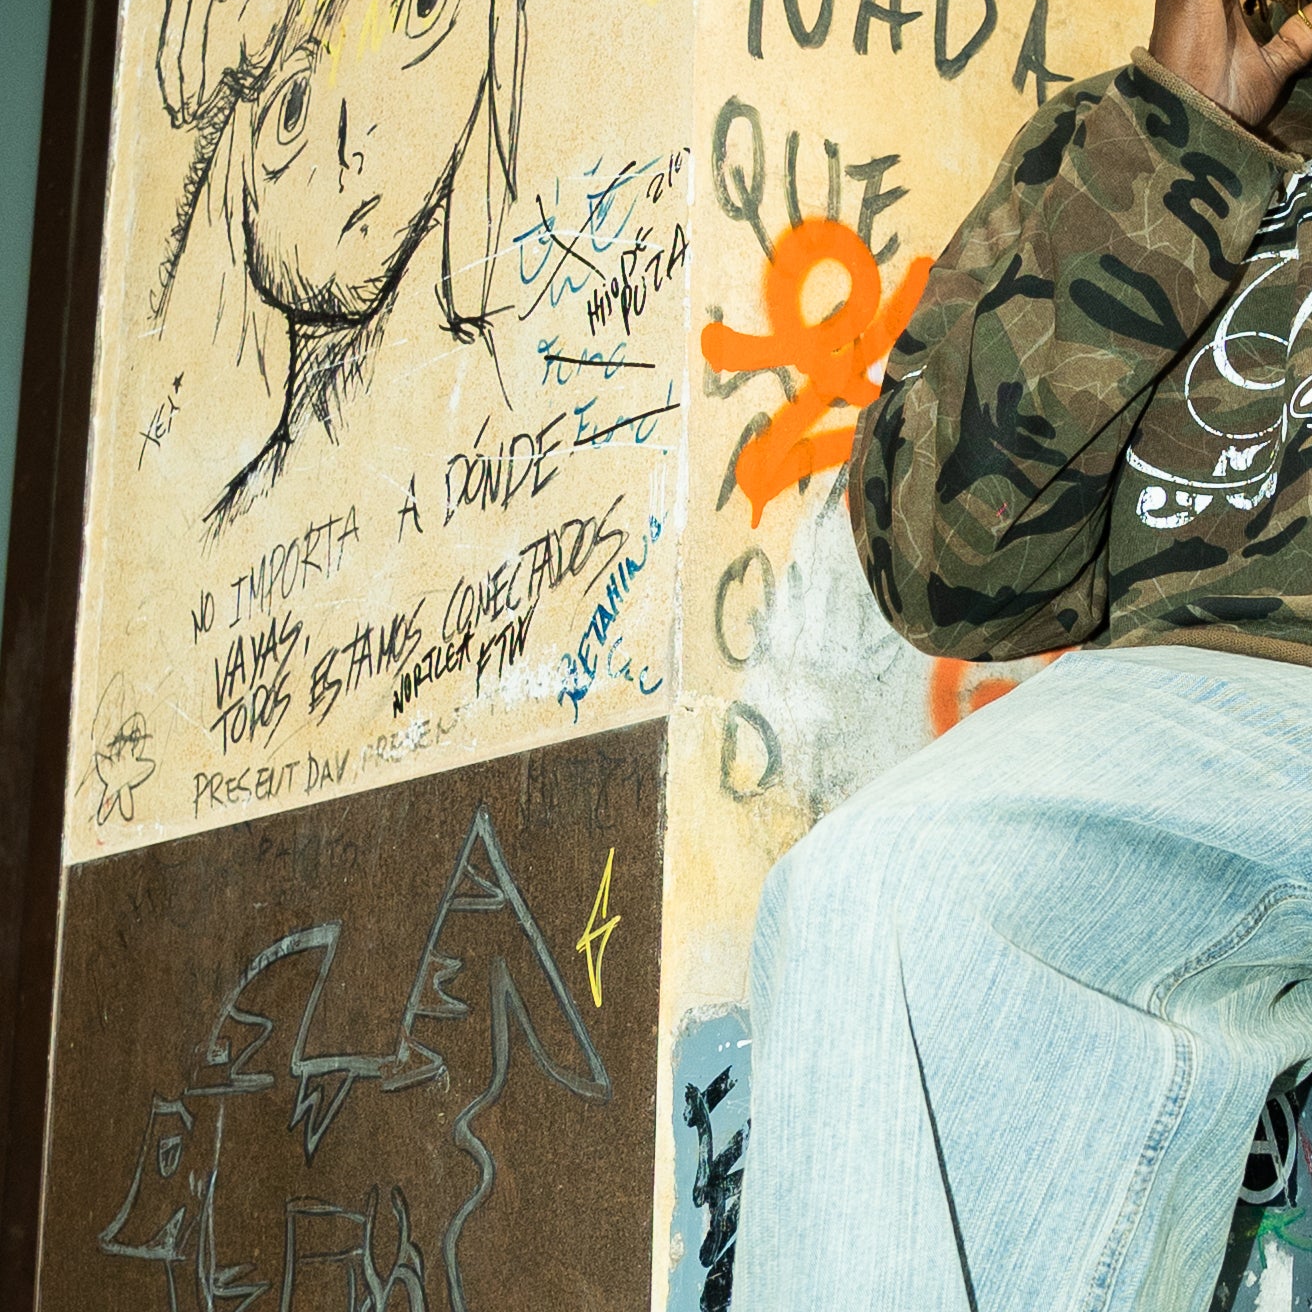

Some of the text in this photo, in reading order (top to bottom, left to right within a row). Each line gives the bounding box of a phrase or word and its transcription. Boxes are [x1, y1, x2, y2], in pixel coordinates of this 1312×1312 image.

[191, 590, 216, 645] NO
[229, 505, 360, 628] IMPORTA
[397, 473, 424, 543] A
[192, 760, 295, 819] PRESENT
